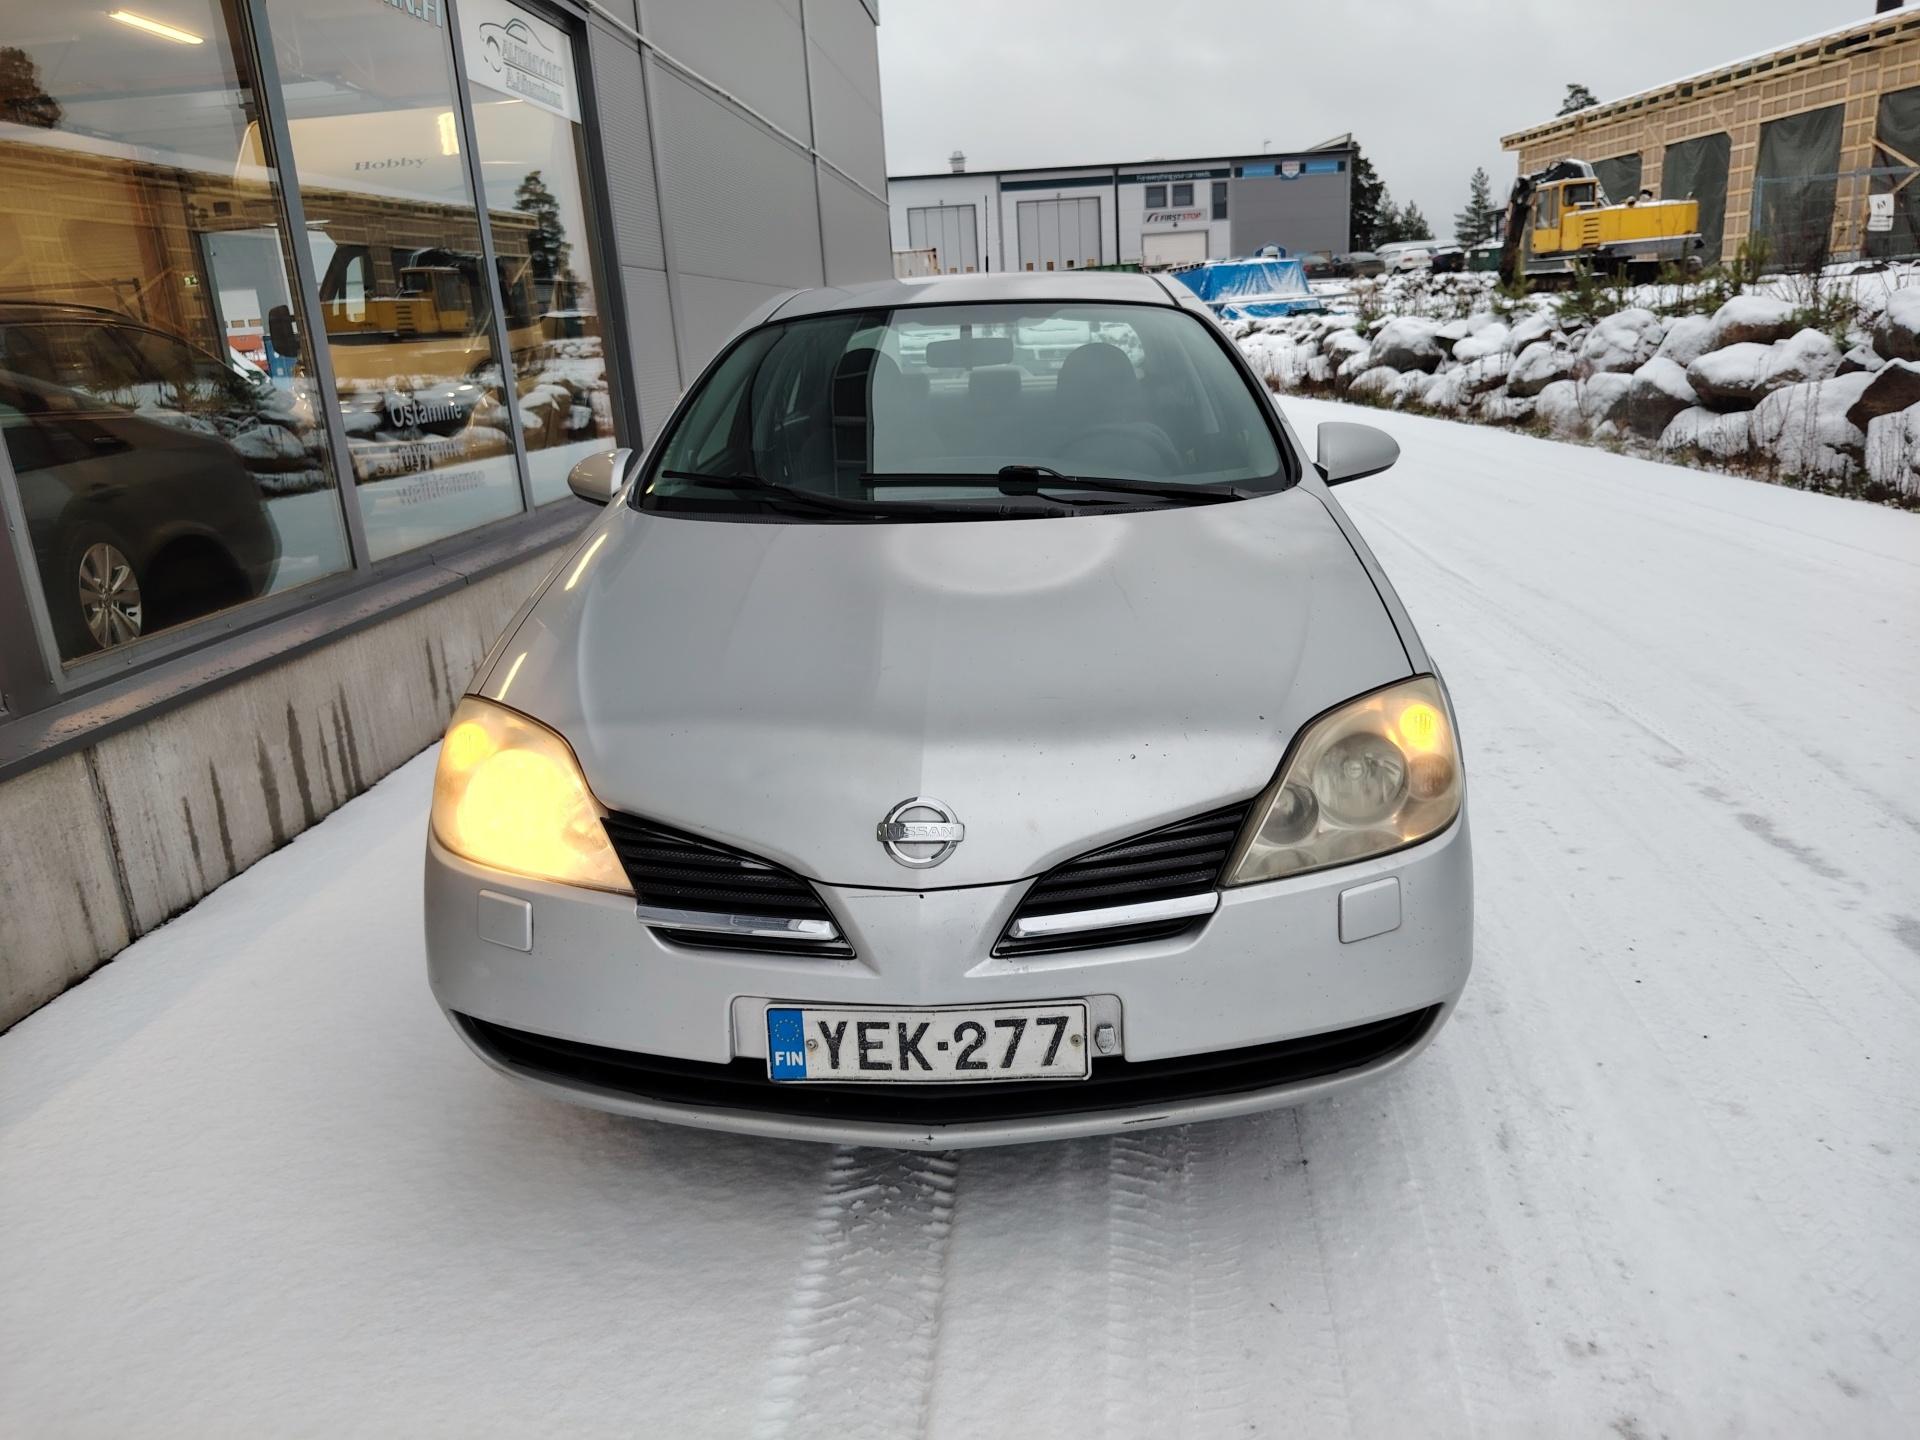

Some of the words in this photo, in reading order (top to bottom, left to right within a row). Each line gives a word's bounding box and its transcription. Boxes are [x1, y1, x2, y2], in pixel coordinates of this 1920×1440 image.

[354, 157, 428, 170] Hobby
[1159, 213, 1182, 222] FIRST
[1182, 211, 1202, 221] STOP
[390, 401, 463, 428] Ostamme
[889, 826, 953, 838] NISSAN
[817, 1015, 1070, 1072] YEK-277
[774, 1050, 804, 1067] FIN
